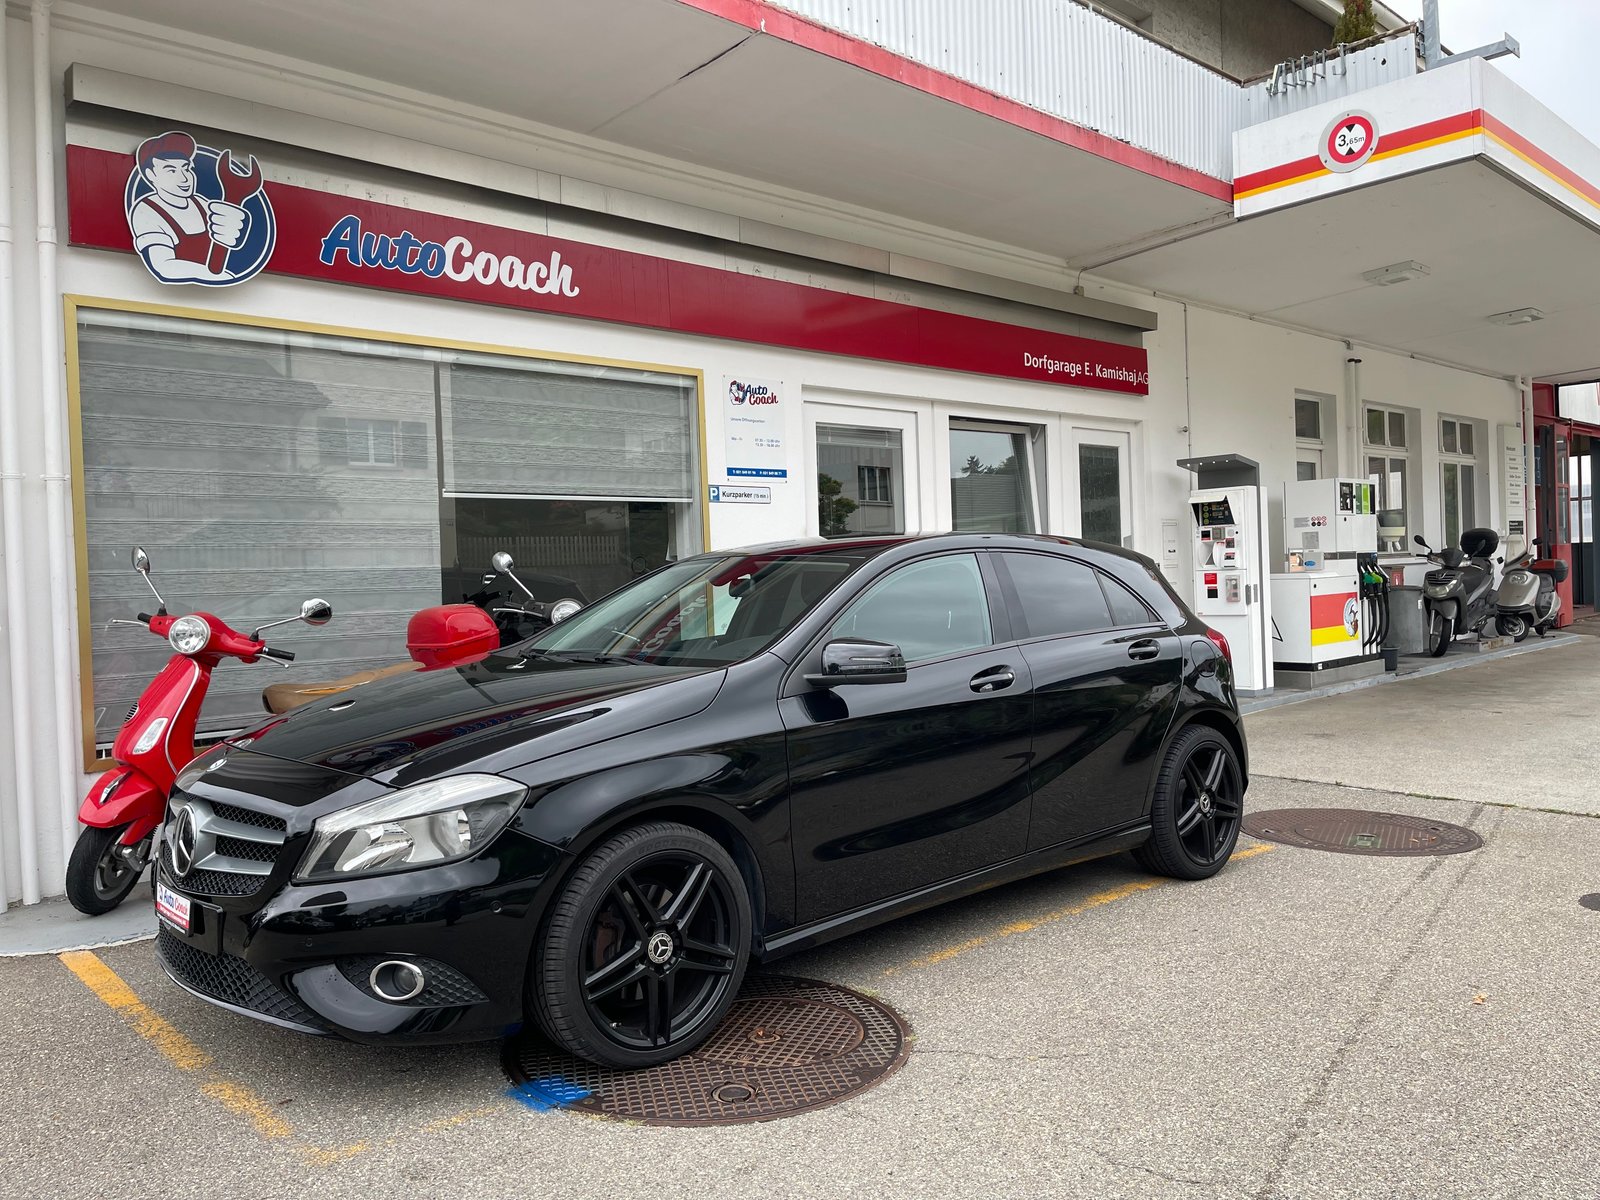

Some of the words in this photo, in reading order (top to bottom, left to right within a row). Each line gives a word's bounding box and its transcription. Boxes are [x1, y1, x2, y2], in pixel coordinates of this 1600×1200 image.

[1338, 134, 1364, 147] 3,65m
[1024, 352, 1082, 377] Dorfgarage
[1085, 362, 1093, 376] E.
[1095, 363, 1137, 385] Kamishaj
[1137, 371, 1149, 384] AG
[745, 384, 768, 396] Auto
[749, 392, 779, 406] Coach
[710, 487, 718, 500] P
[722, 491, 752, 499] Kurzparker
